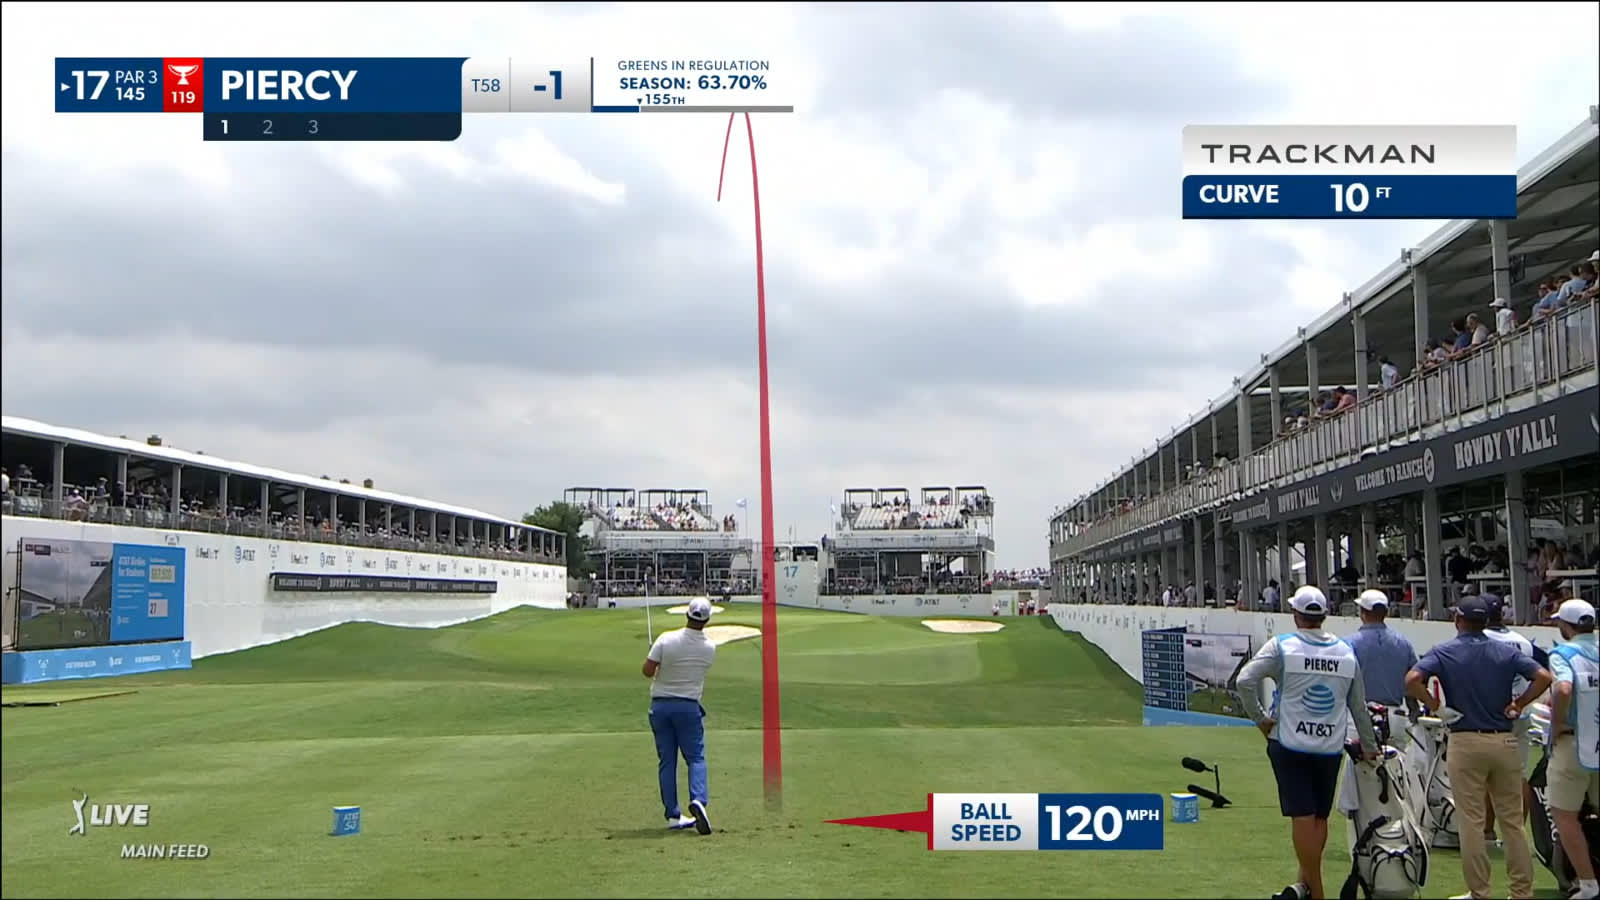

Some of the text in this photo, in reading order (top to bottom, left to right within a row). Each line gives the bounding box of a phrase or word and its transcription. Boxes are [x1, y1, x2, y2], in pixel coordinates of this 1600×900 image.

[1454, 414, 1558, 470] HOWDY Y'ALL!
[1354, 457, 1424, 492] WELCOME TO RANCH
[784, 566, 798, 577] 17
[1304, 657, 1340, 673] PIERCY
[1295, 720, 1336, 738] AT&T
